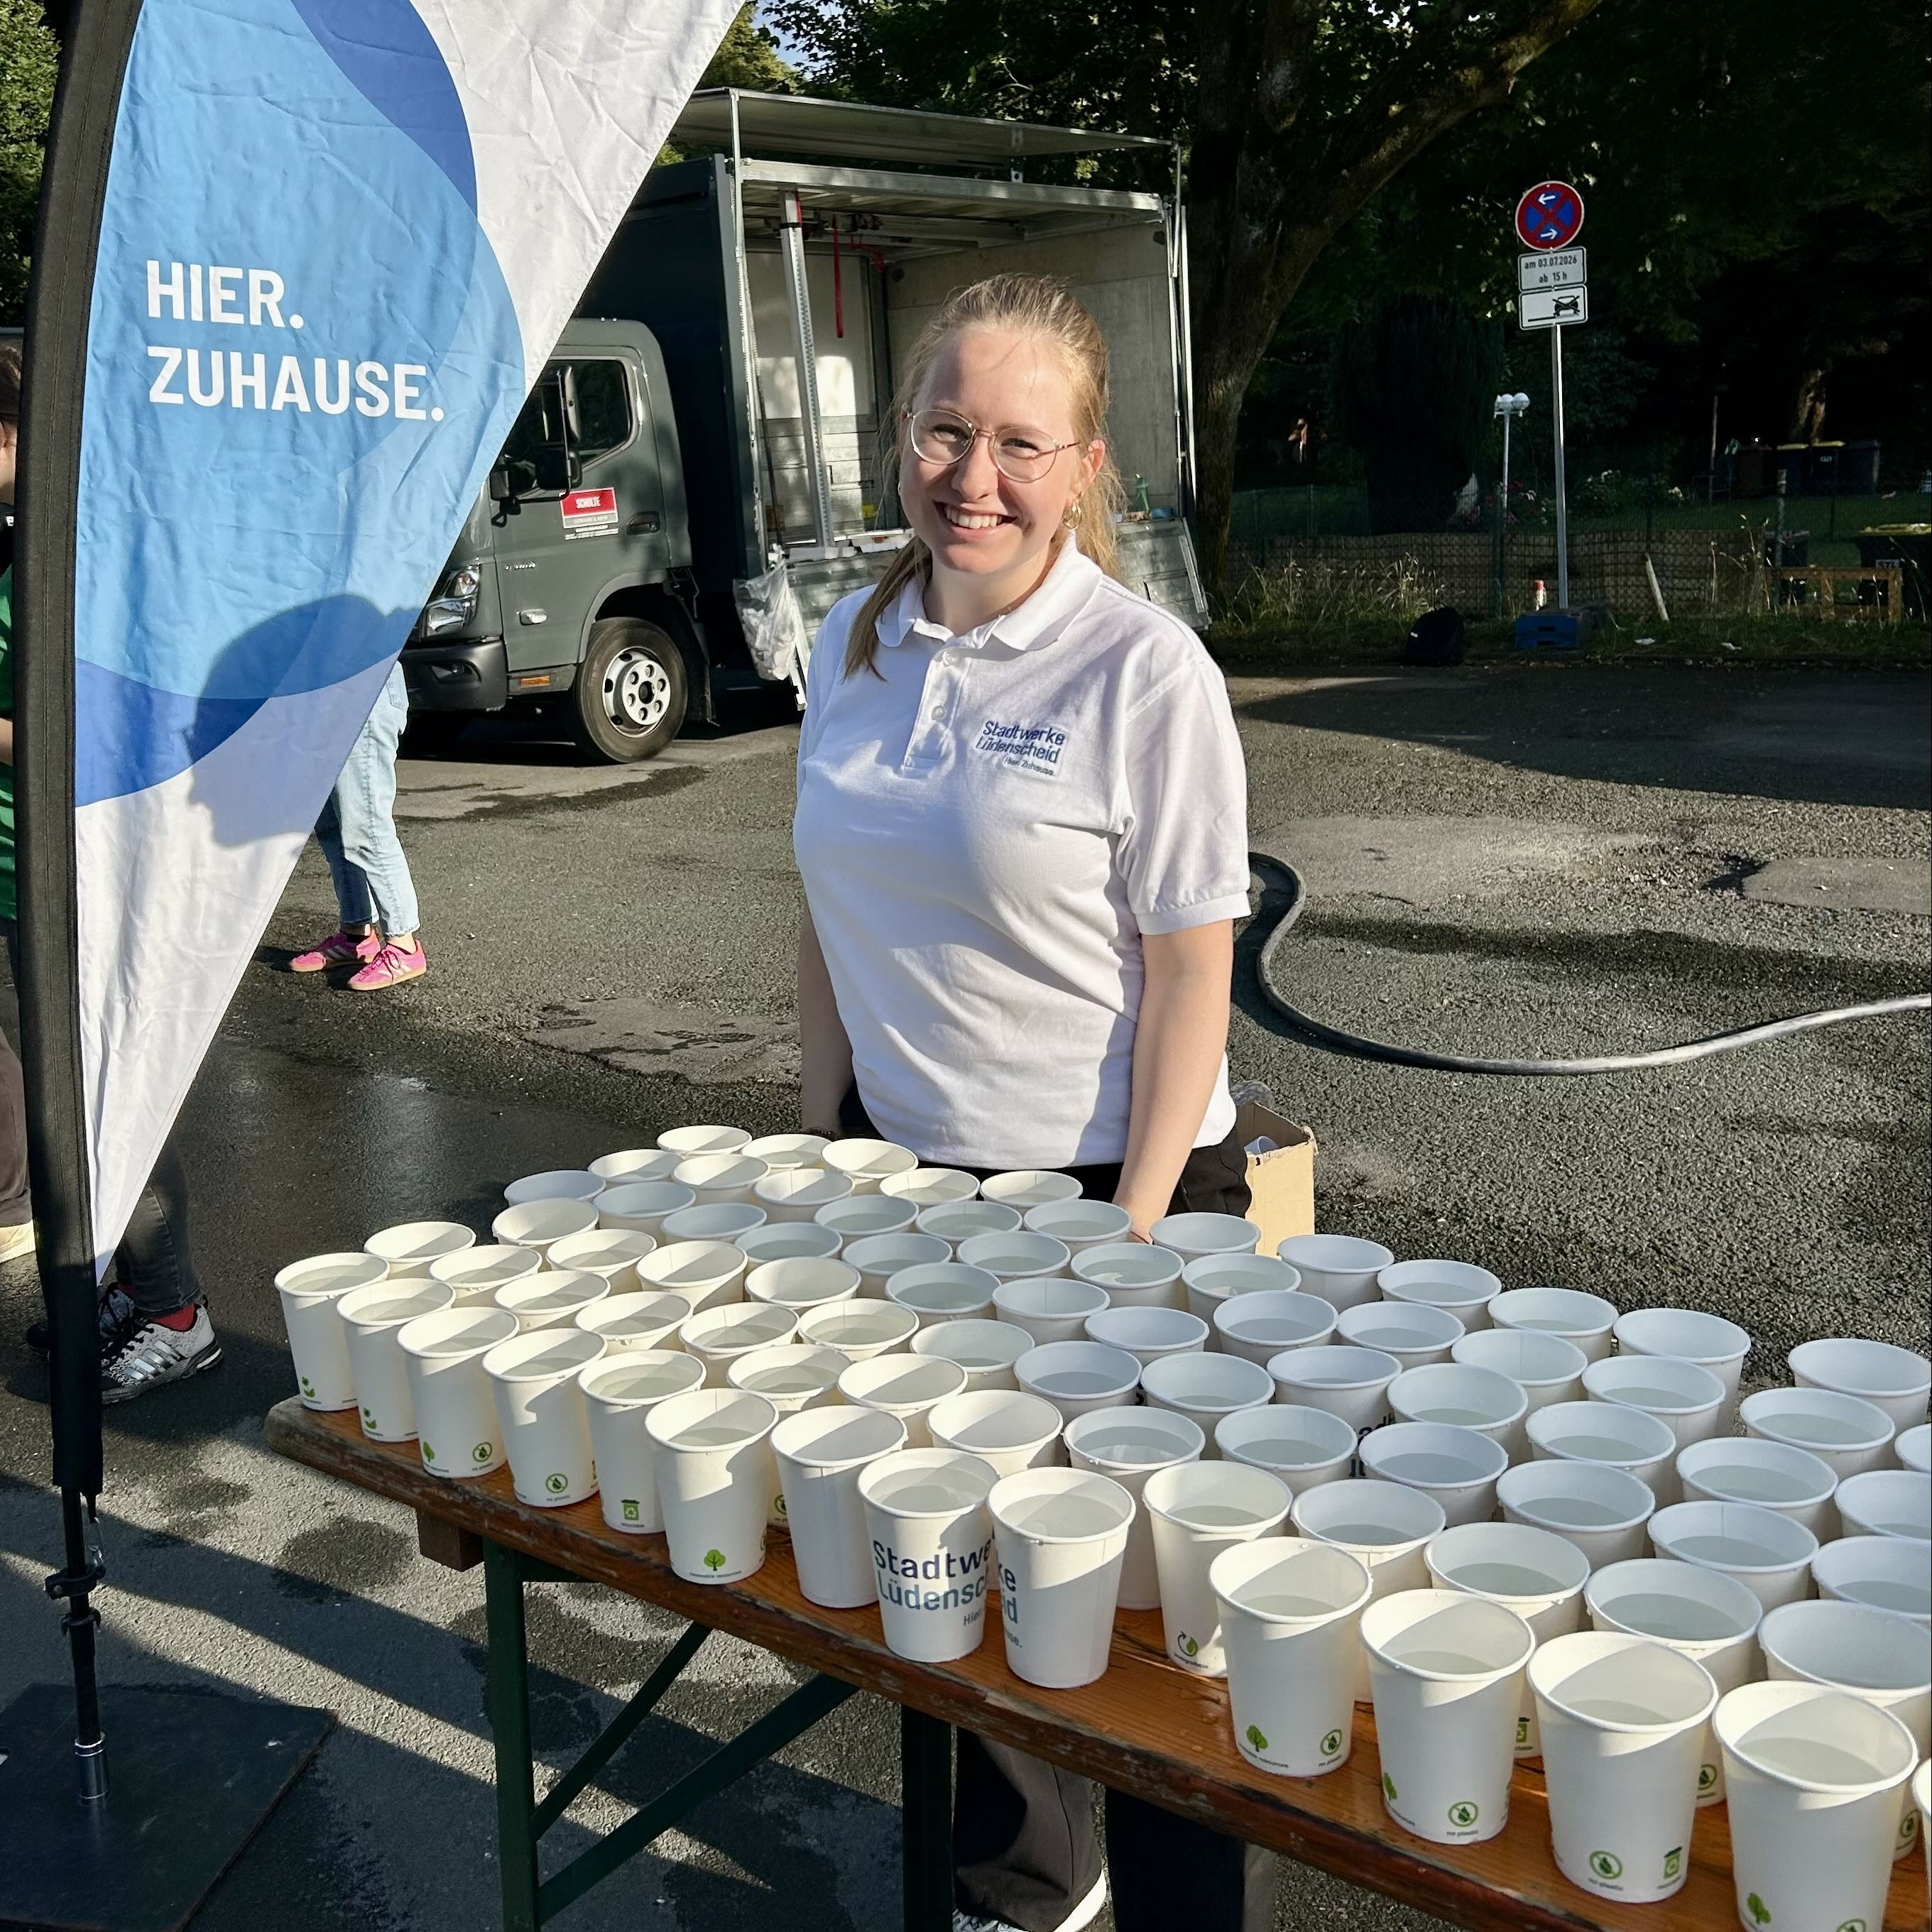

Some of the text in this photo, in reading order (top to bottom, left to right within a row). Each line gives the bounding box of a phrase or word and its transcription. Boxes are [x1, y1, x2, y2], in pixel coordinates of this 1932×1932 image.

[1538, 256, 1577, 268] 03.07.2026
[1539, 271, 1567, 283] ab 15 h
[147, 259, 304, 329] HIER.
[147, 346, 444, 422] ZUHAUSE.
[983, 720, 1065, 746] Stadtwerke
[975, 736, 1061, 763] Lüdenscheid
